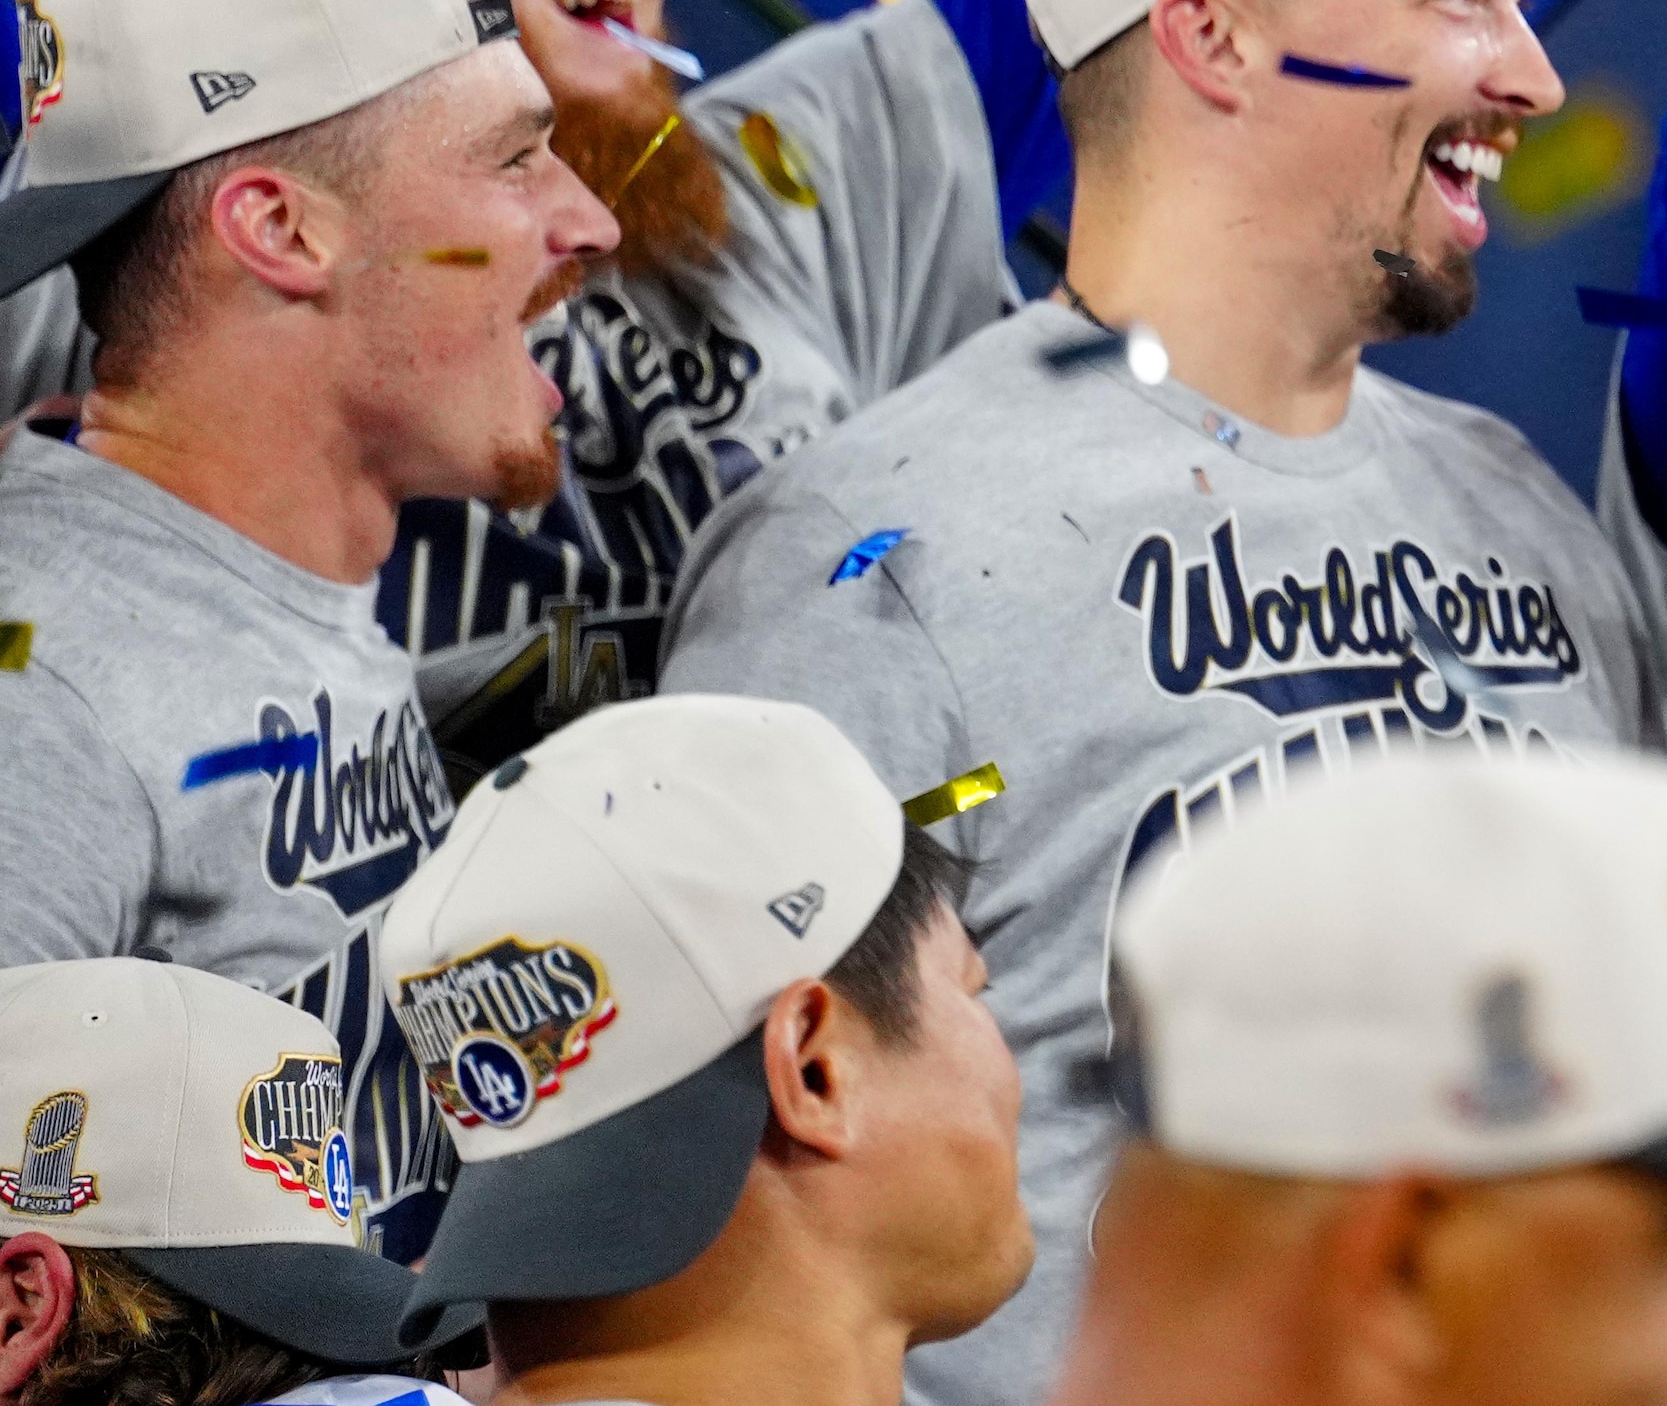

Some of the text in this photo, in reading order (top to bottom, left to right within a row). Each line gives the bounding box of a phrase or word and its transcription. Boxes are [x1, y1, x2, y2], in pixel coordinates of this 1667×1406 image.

[1118, 508, 1582, 735] World Series
[460, 1052, 522, 1116] LA
[331, 1144, 351, 1210] LA
